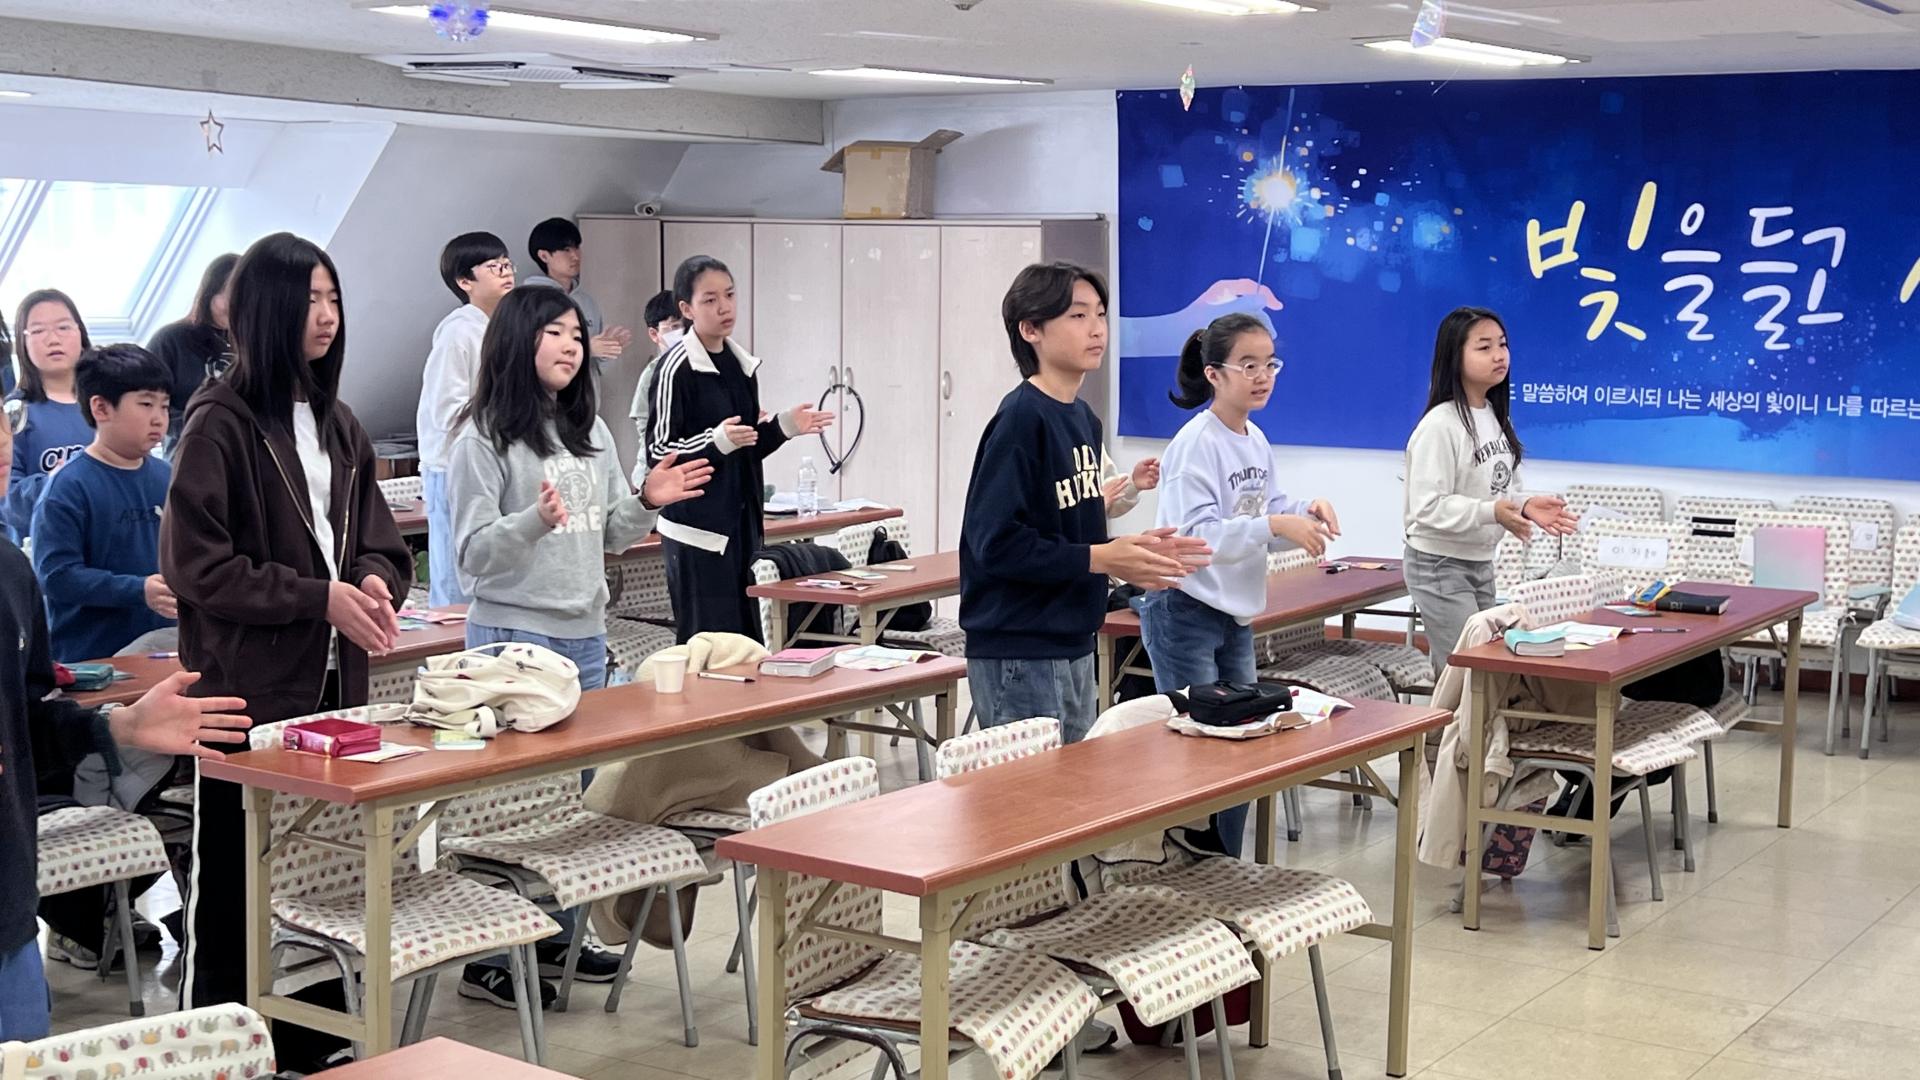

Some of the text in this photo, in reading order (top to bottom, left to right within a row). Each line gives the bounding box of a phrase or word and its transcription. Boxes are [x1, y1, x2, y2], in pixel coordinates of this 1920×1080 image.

[1526, 181, 1846, 350] 빛을 들고
[1522, 383, 1588, 405] 말씀하여
[1594, 386, 1661, 408] 이르시되
[1667, 389, 1702, 410] 나는
[1707, 391, 1760, 413] 세상의
[1766, 391, 1818, 416] 빛이니
[1826, 395, 1864, 417] 나를
[1870, 397, 1920, 420] 따르는
